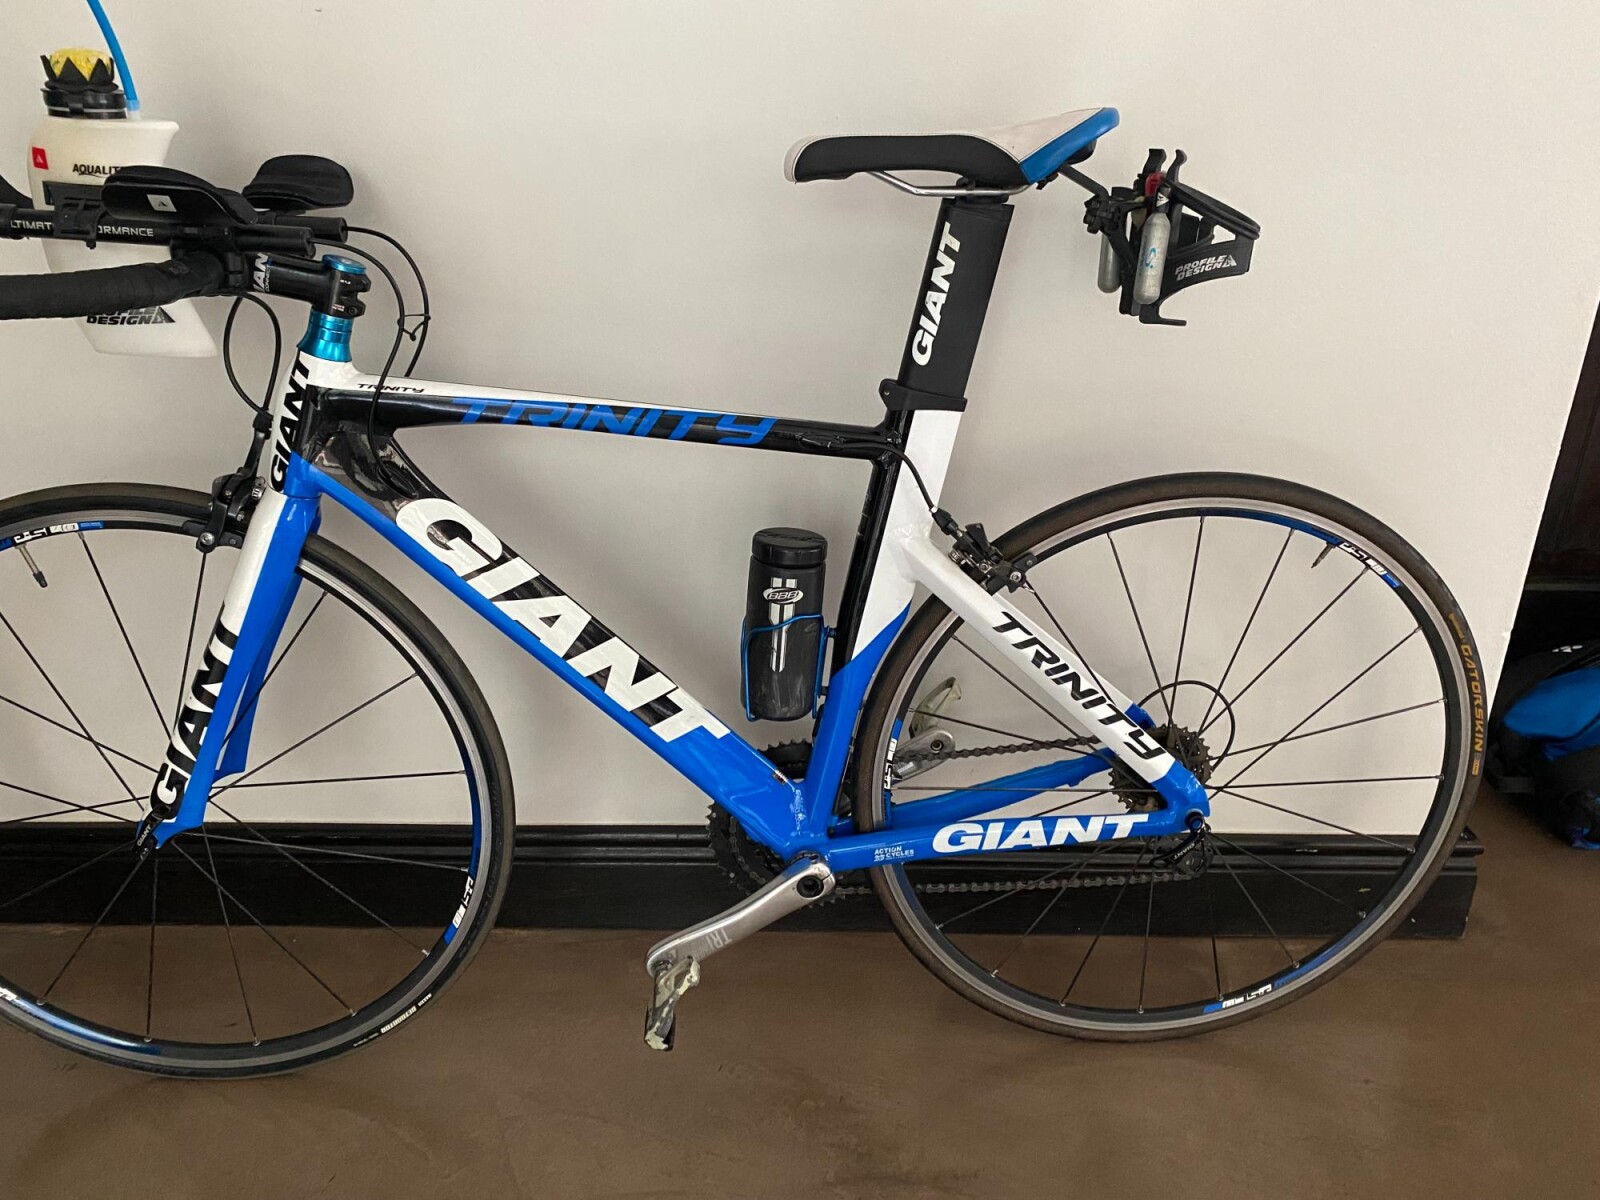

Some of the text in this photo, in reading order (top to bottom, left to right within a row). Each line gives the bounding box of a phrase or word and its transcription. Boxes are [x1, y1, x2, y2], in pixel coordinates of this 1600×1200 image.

[72, 163, 120, 178] AQUALIT
[10, 219, 54, 231] LTIMAT
[1175, 254, 1228, 275] PROFILE
[1176, 262, 1223, 282] DESIGN
[912, 222, 961, 367] GIANT
[86, 314, 151, 326] DESIGN
[357, 383, 425, 394] TRNITY
[271, 349, 310, 493] GIANT
[452, 396, 778, 445] TRINITY
[769, 589, 799, 600] BBB
[395, 498, 731, 743] GIANT
[992, 611, 1168, 760] TRINITY
[1460, 643, 1484, 753] GATORSKIN
[932, 813, 1150, 854] GIANT
[874, 845, 903, 856] ACTION
[885, 849, 915, 858] CYCLES
